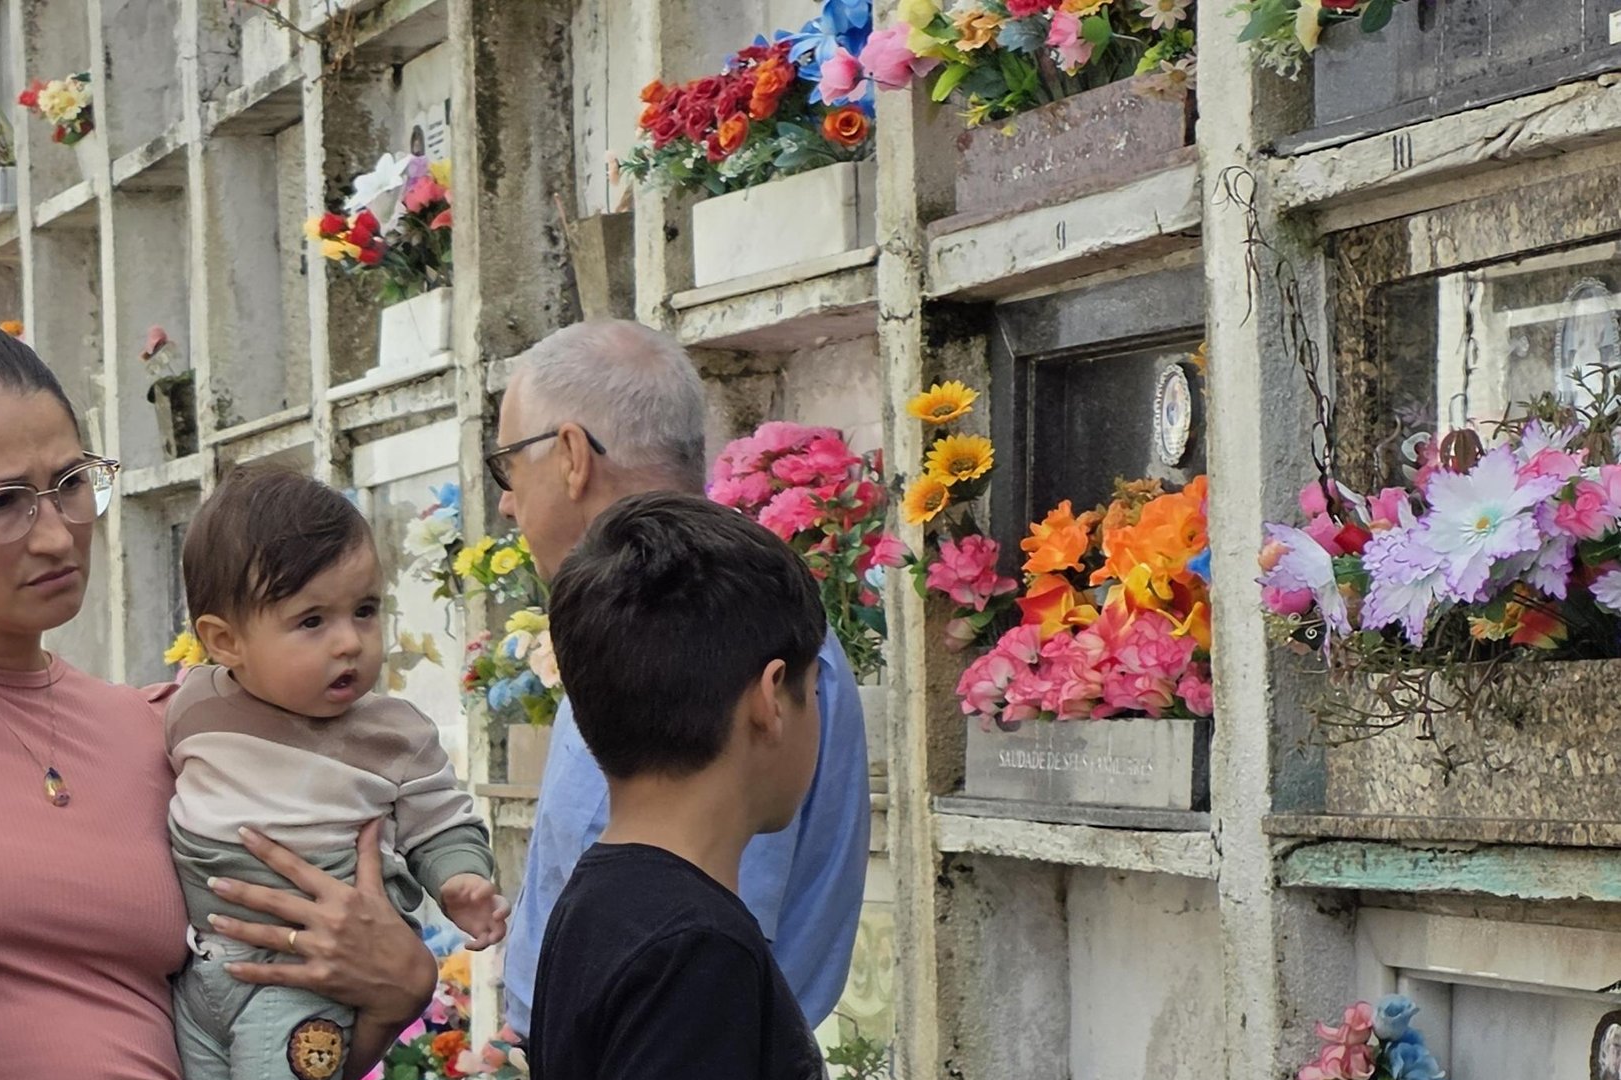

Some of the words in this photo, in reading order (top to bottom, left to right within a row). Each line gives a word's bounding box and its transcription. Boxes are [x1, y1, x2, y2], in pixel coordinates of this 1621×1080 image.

[1392, 131, 1412, 171] 10
[999, 750, 1046, 770] SAUDADE
[1046, 751, 1062, 771] DE
